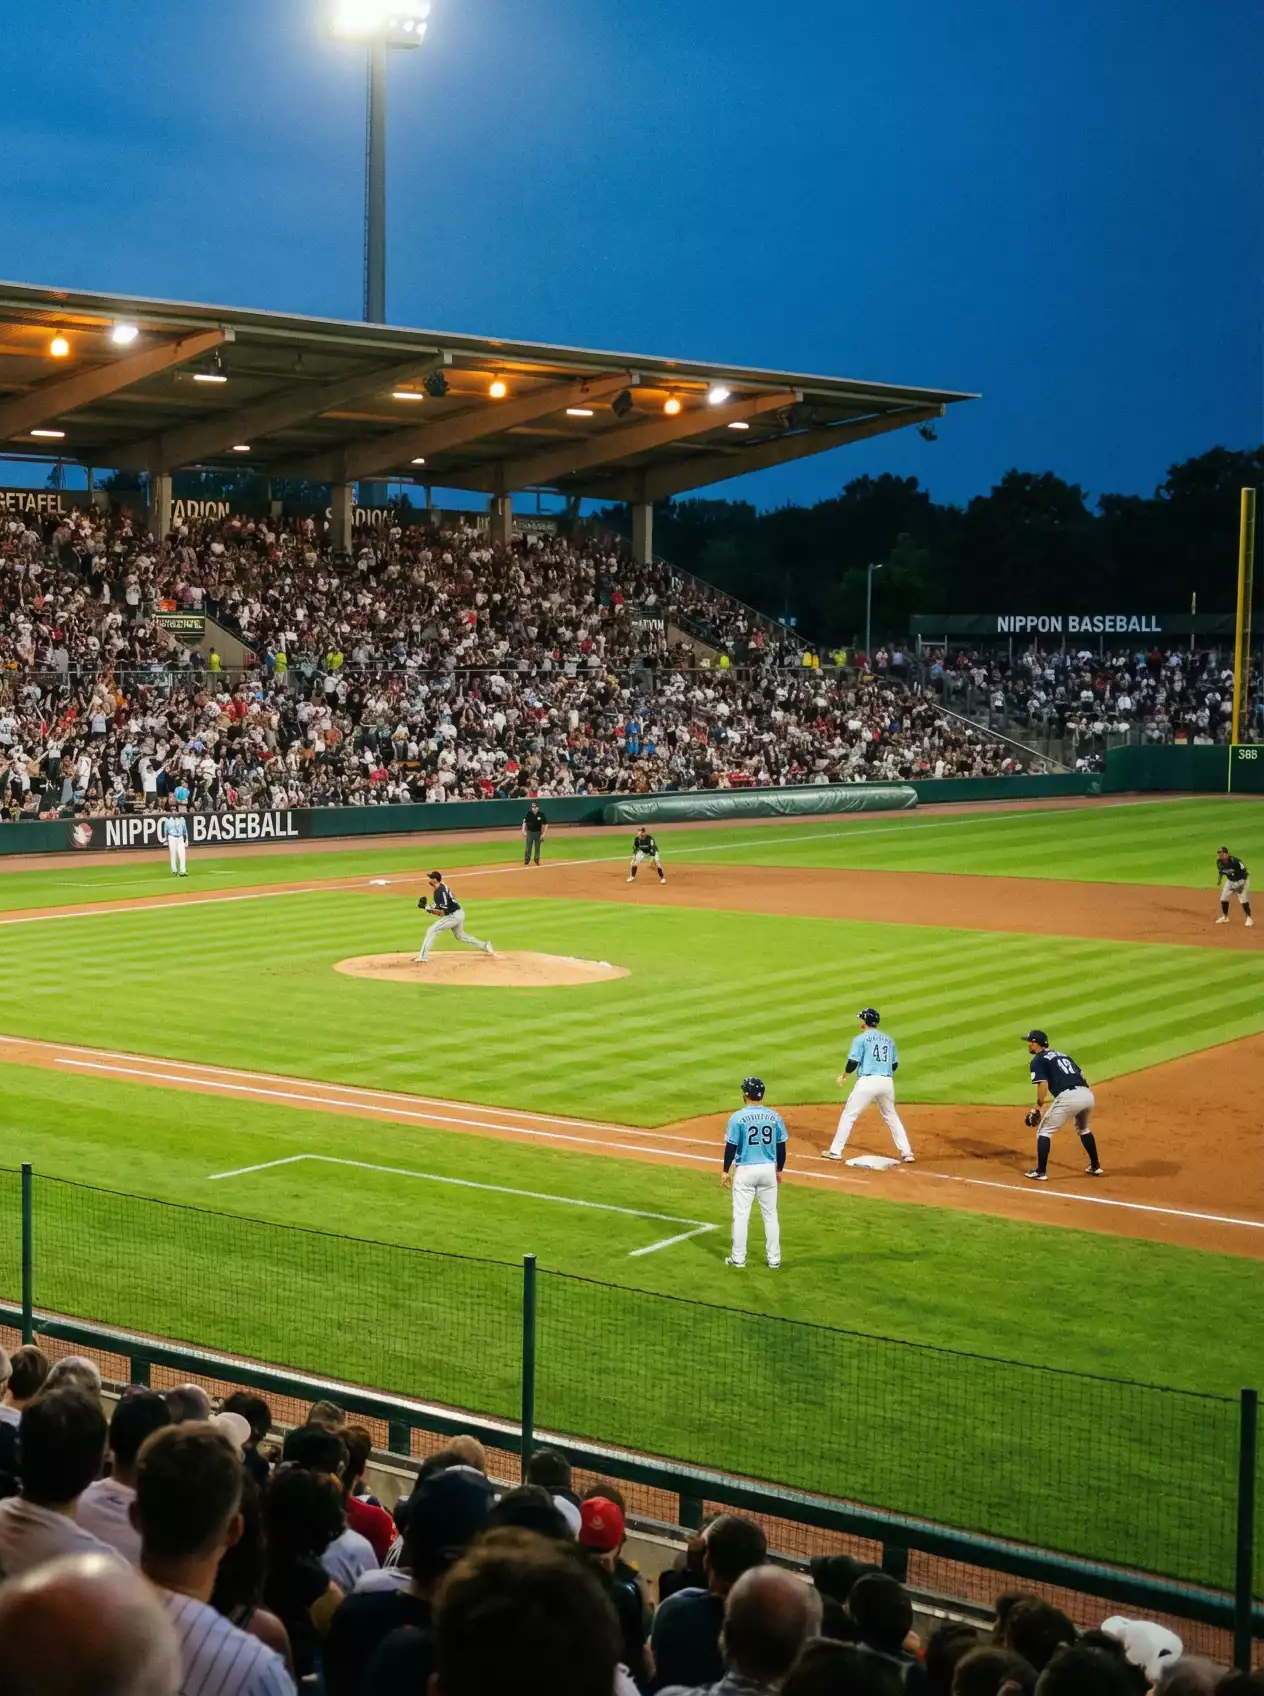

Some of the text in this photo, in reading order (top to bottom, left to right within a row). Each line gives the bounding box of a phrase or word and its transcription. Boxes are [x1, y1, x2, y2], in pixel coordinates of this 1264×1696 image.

[997, 615, 1162, 633] NIPPON BASEBALL
[105, 811, 299, 846] NIPPO BASEBALL
[748, 1125, 773, 1146] 29
